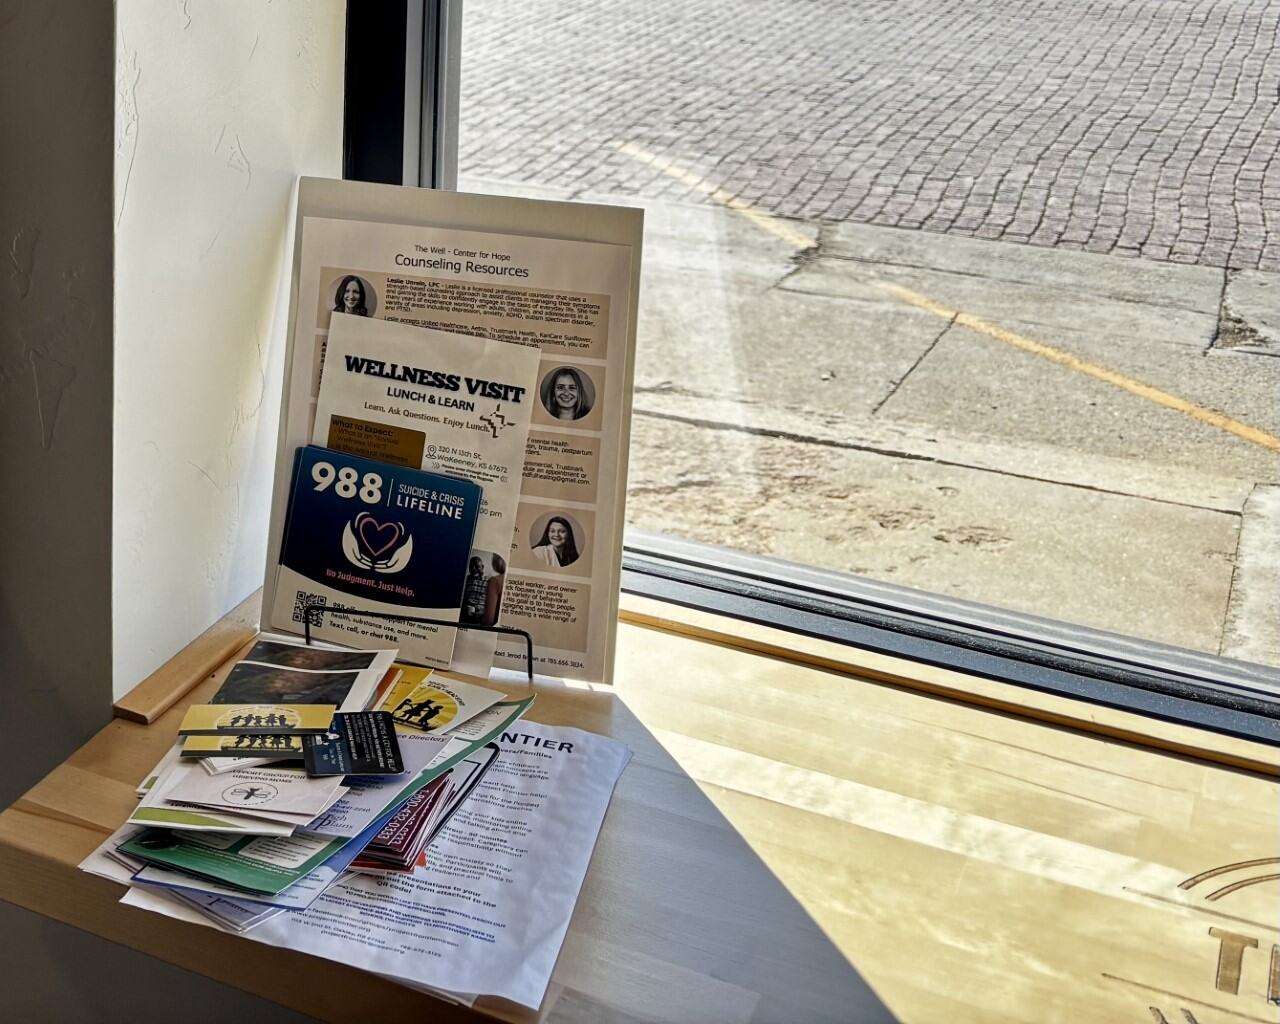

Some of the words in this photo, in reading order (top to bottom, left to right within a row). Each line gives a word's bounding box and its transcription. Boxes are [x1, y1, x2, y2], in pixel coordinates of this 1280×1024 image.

[414, 244, 428, 253] The
[430, 246, 446, 255] Well
[453, 248, 477, 258] Center
[479, 251, 489, 259] for
[491, 253, 511, 262] Hope
[395, 253, 462, 274] Counseling
[465, 261, 529, 278] Resources
[344, 354, 461, 392] WELLNESS
[464, 376, 526, 403] VISIT
[387, 386, 427, 403] LUNCH
[427, 394, 436, 405] &
[438, 396, 475, 412] LEARN
[388, 406, 401, 416] Ask
[443, 417, 465, 430] Enjoy
[488, 464, 508, 474] 67672
[310, 460, 384, 505] 988
[398, 483, 430, 499] SUICIDE
[430, 492, 439, 502] &
[438, 492, 465, 507] CRISIS
[396, 494, 465, 521] LIFELINE
[337, 570, 377, 589] Judgment.
[378, 579, 395, 592] Just
[395, 583, 416, 597] Help.
[329, 620, 345, 631] Text,
[352, 616, 382, 630] substance
[383, 624, 396, 634] use,
[396, 627, 410, 637] and
[406, 619, 416, 628] for
[416, 622, 439, 633] mental
[408, 734, 448, 743] Directory
[499, 731, 574, 754] NTIER
[401, 879, 415, 888] the
[416, 884, 435, 894] form
[436, 889, 471, 902] attached
[463, 888, 482, 898] your
